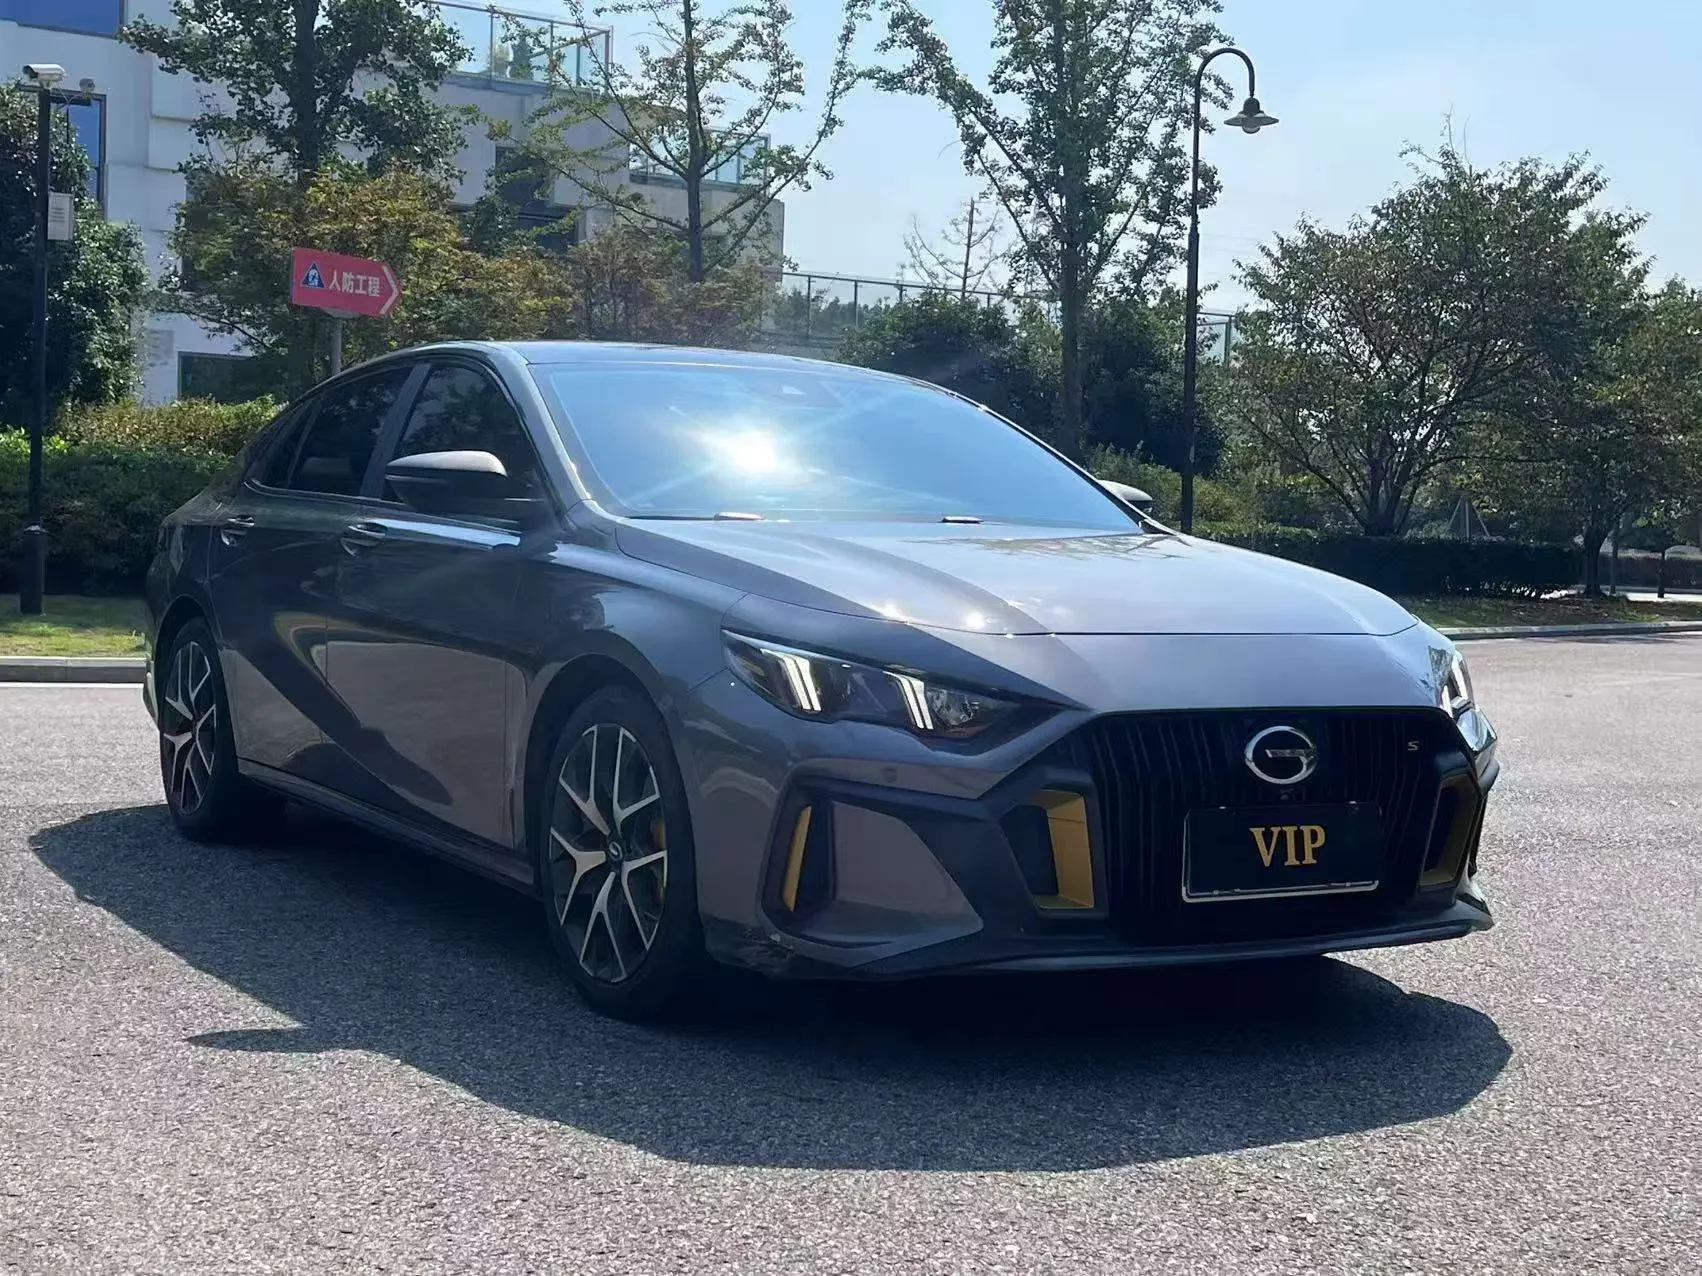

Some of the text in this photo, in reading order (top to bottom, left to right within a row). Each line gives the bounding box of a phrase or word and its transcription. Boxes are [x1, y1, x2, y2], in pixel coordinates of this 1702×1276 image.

[328, 270, 380, 296] 人防工程
[1249, 825, 1326, 867] VIP
